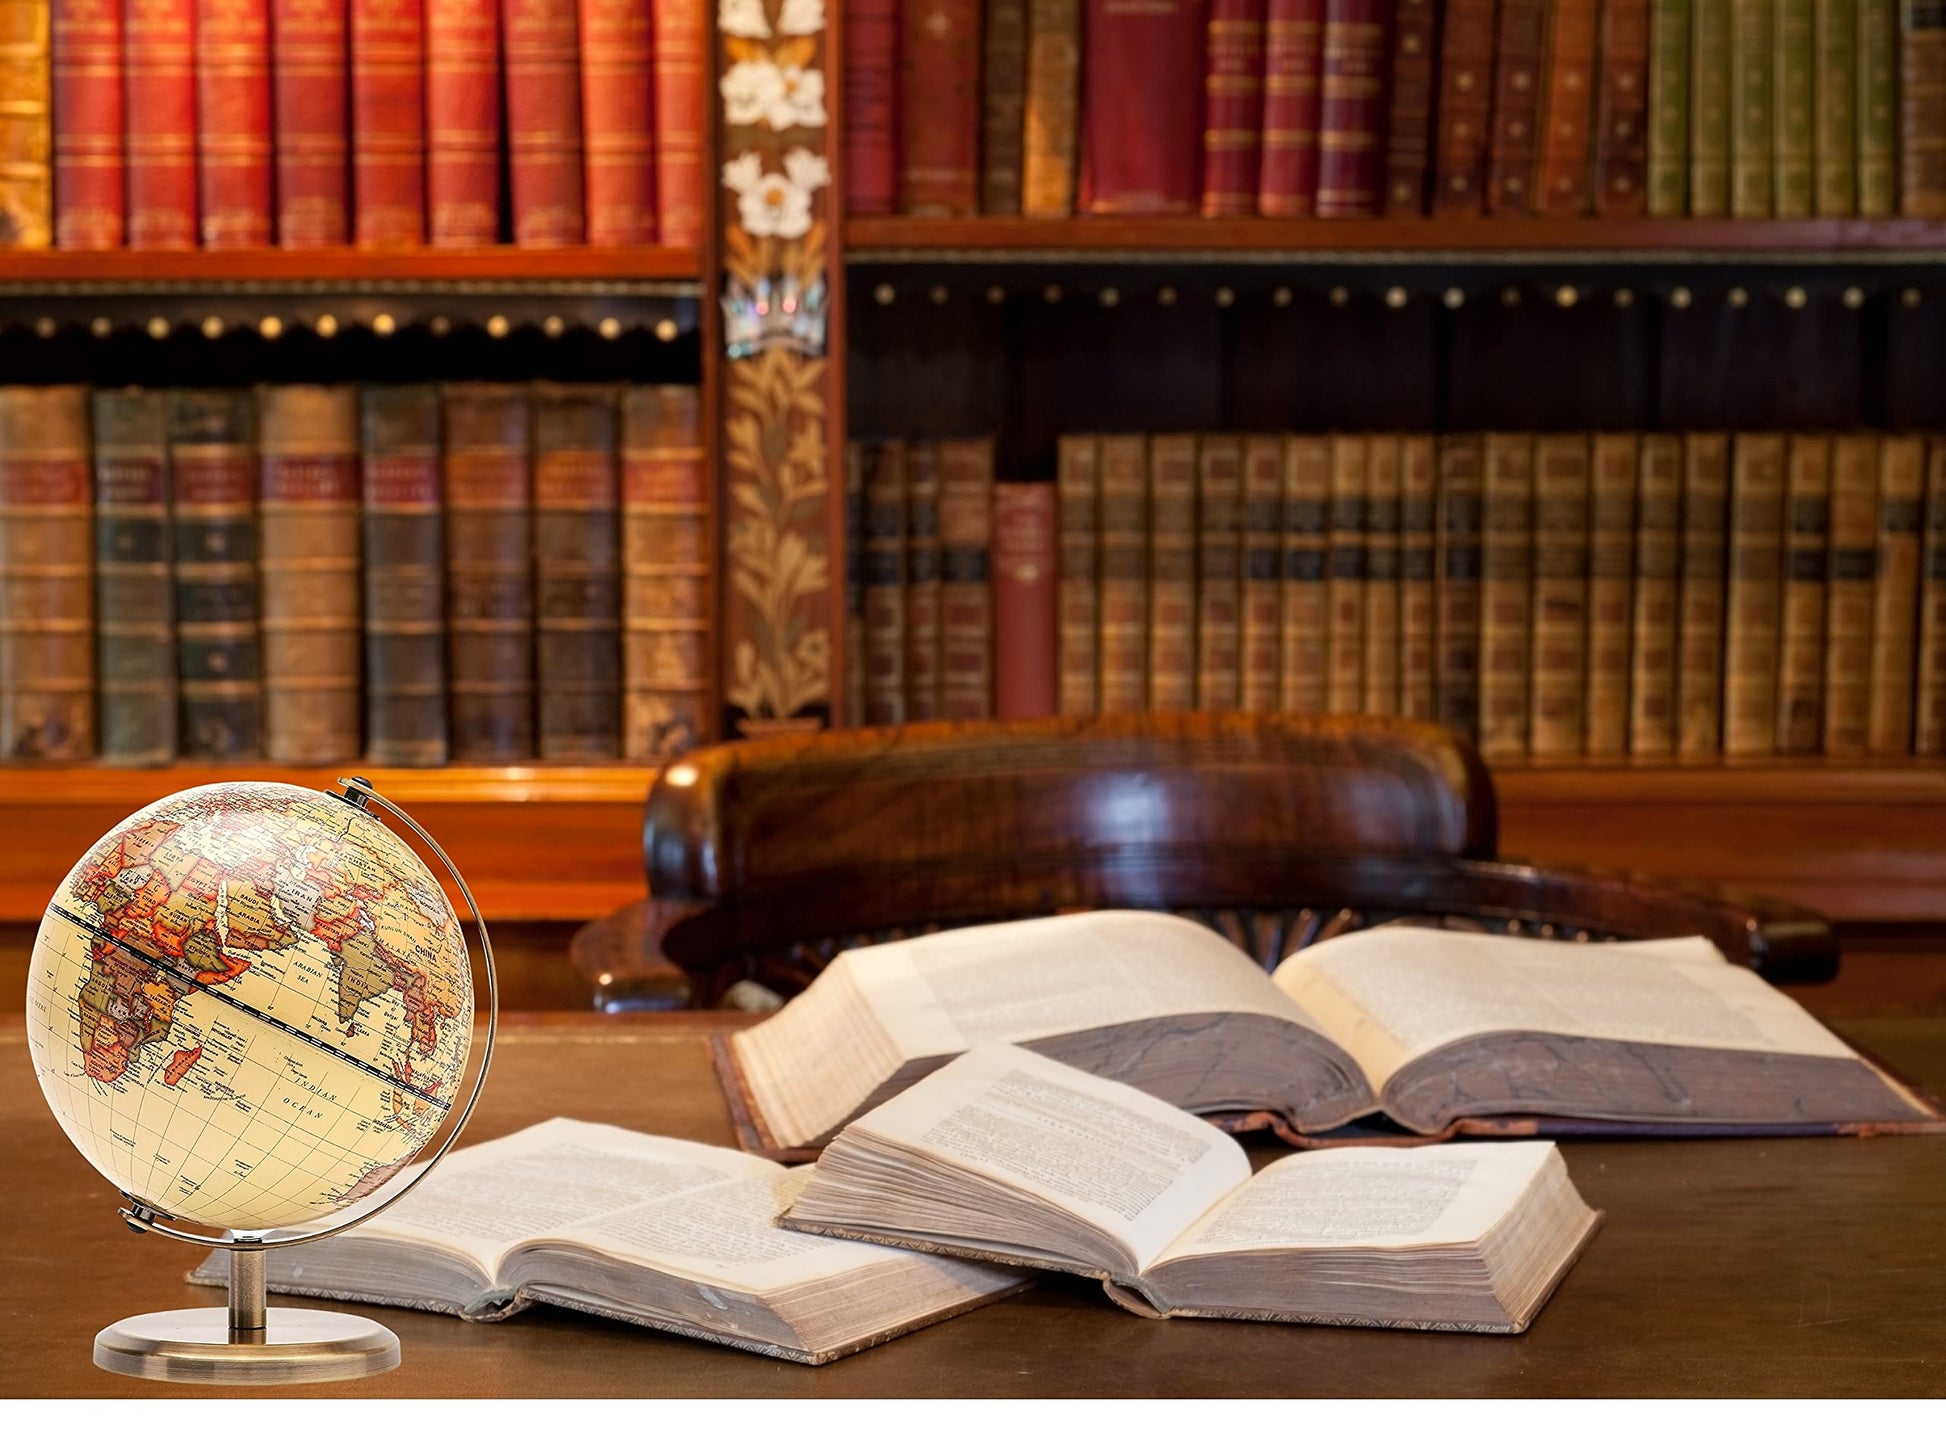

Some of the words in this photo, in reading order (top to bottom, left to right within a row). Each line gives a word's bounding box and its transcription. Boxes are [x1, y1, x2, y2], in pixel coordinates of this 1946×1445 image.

[240, 894, 259, 905] SAUDI
[291, 889, 313, 902] IRAN
[238, 912, 260, 924] ARABIA
[415, 944, 438, 963] CHINA
[293, 961, 323, 978] ARABIAN
[296, 975, 309, 984] SEA
[347, 976, 369, 990] INDIA
[295, 1077, 337, 1101] INDIAN
[282, 1097, 324, 1119] OCEAN
